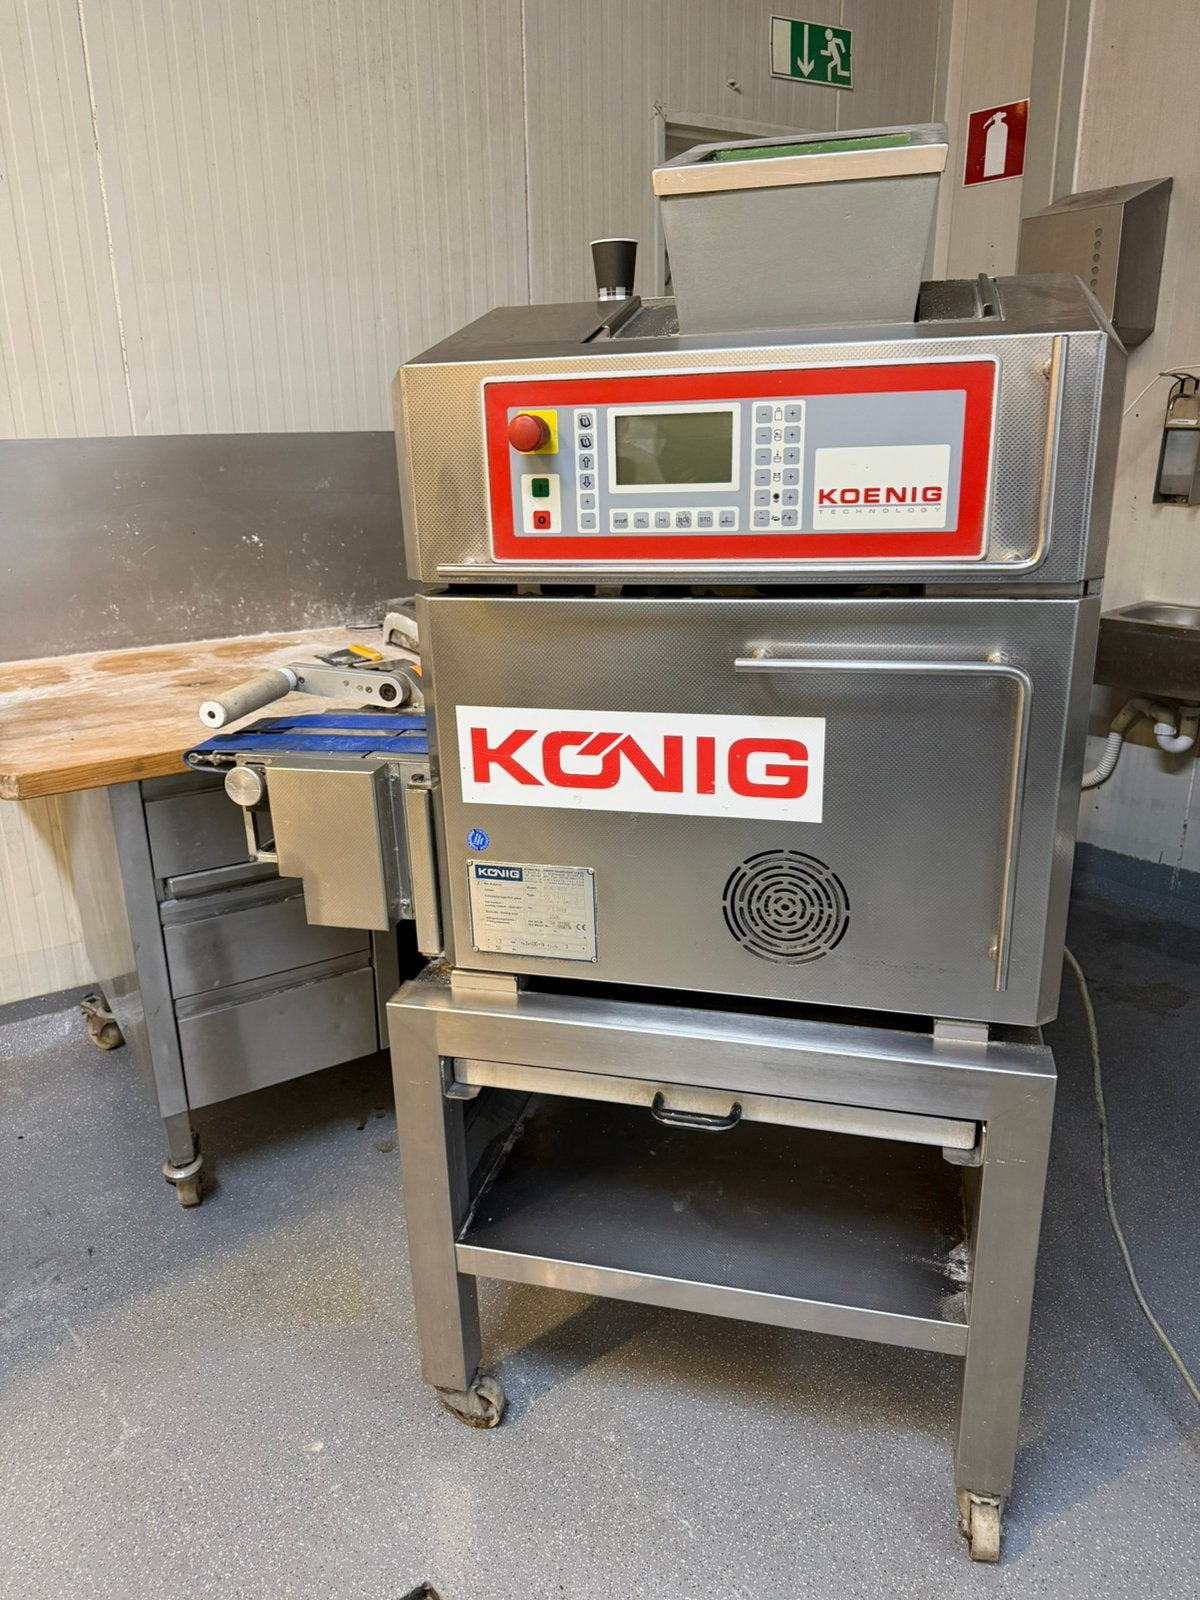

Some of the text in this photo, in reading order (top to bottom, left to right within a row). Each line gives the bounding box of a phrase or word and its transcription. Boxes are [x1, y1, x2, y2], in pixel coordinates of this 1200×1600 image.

[818, 486, 943, 504] KOENIG
[818, 507, 941, 515] TECHNOLOGY
[470, 727, 809, 799] KÖNIG
